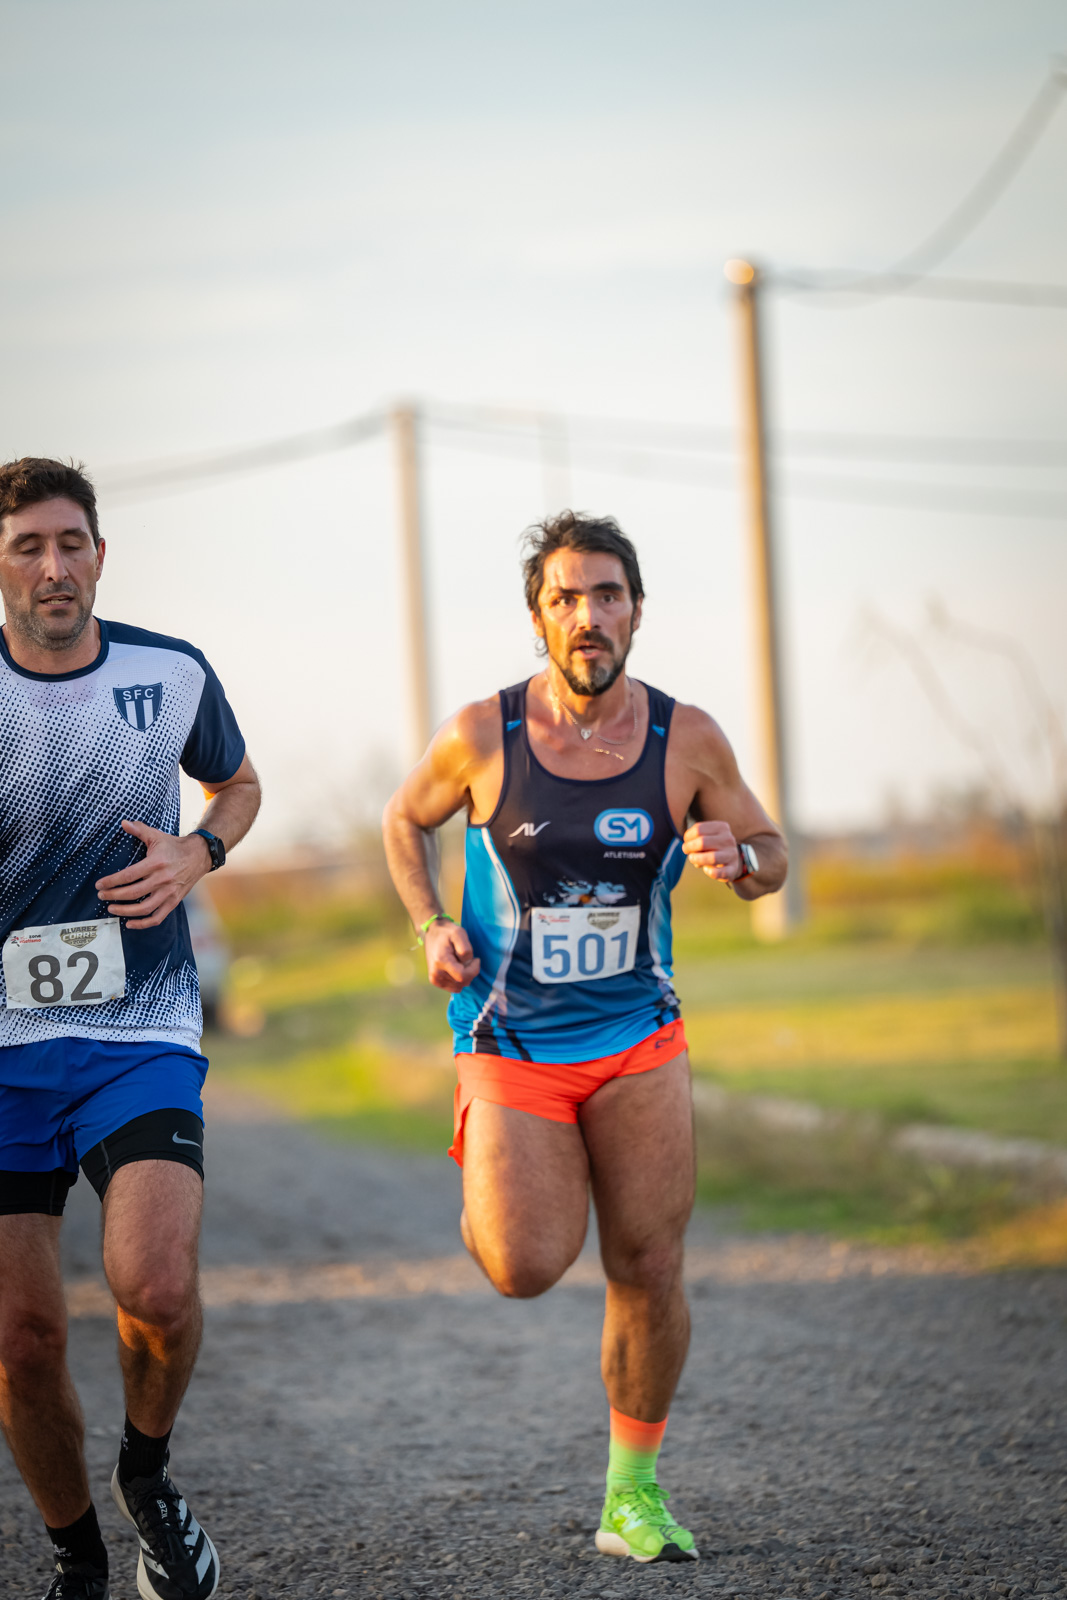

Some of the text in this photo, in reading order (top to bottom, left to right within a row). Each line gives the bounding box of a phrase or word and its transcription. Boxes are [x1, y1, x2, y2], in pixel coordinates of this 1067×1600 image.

[122, 688, 154, 701] SFC
[603, 851, 646, 859] ATLETISMO
[60, 925, 98, 935] ALVAREZ
[62, 931, 96, 941] CORRE
[543, 931, 628, 978] 501
[28, 951, 102, 1003] 82
